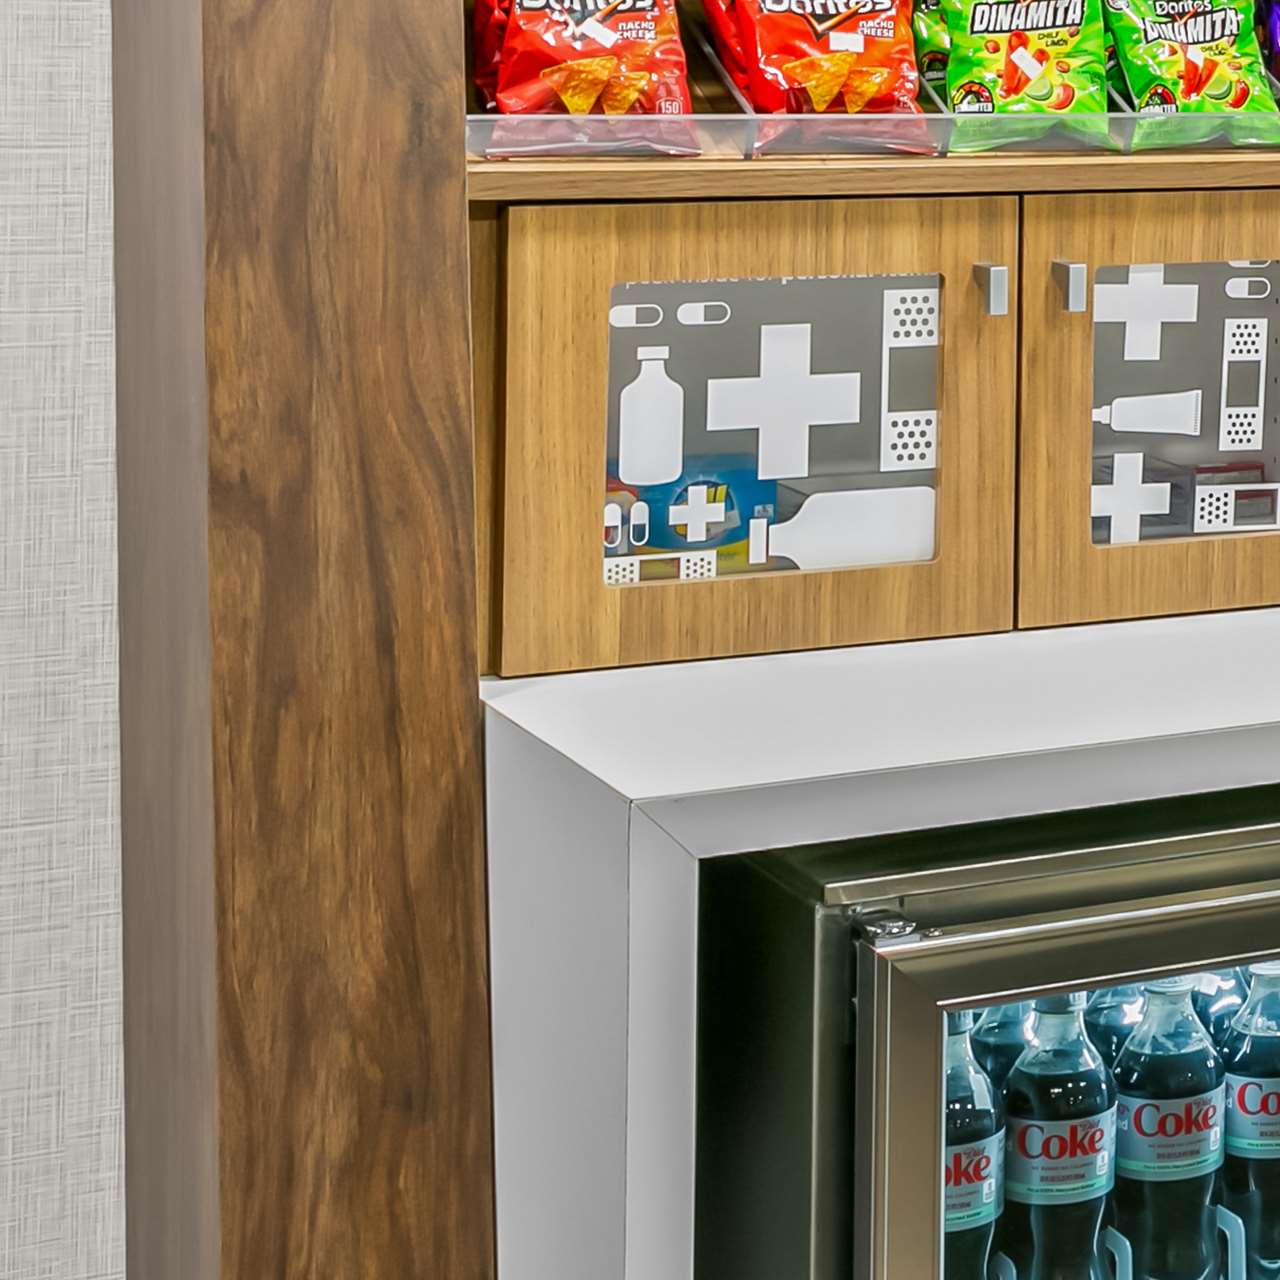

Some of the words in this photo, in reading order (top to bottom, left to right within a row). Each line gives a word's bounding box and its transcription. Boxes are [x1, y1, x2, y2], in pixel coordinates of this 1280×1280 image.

[618, 21, 656, 31] NACHO
[857, 27, 895, 38] CHEESE
[858, 19, 895, 30] NACHO
[1145, 7, 1240, 44] DINAMITA
[660, 101, 680, 114] 150
[1133, 1102, 1217, 1138] Coke
[1016, 1123, 1105, 1160] Coke
[944, 1152, 991, 1187] oke
